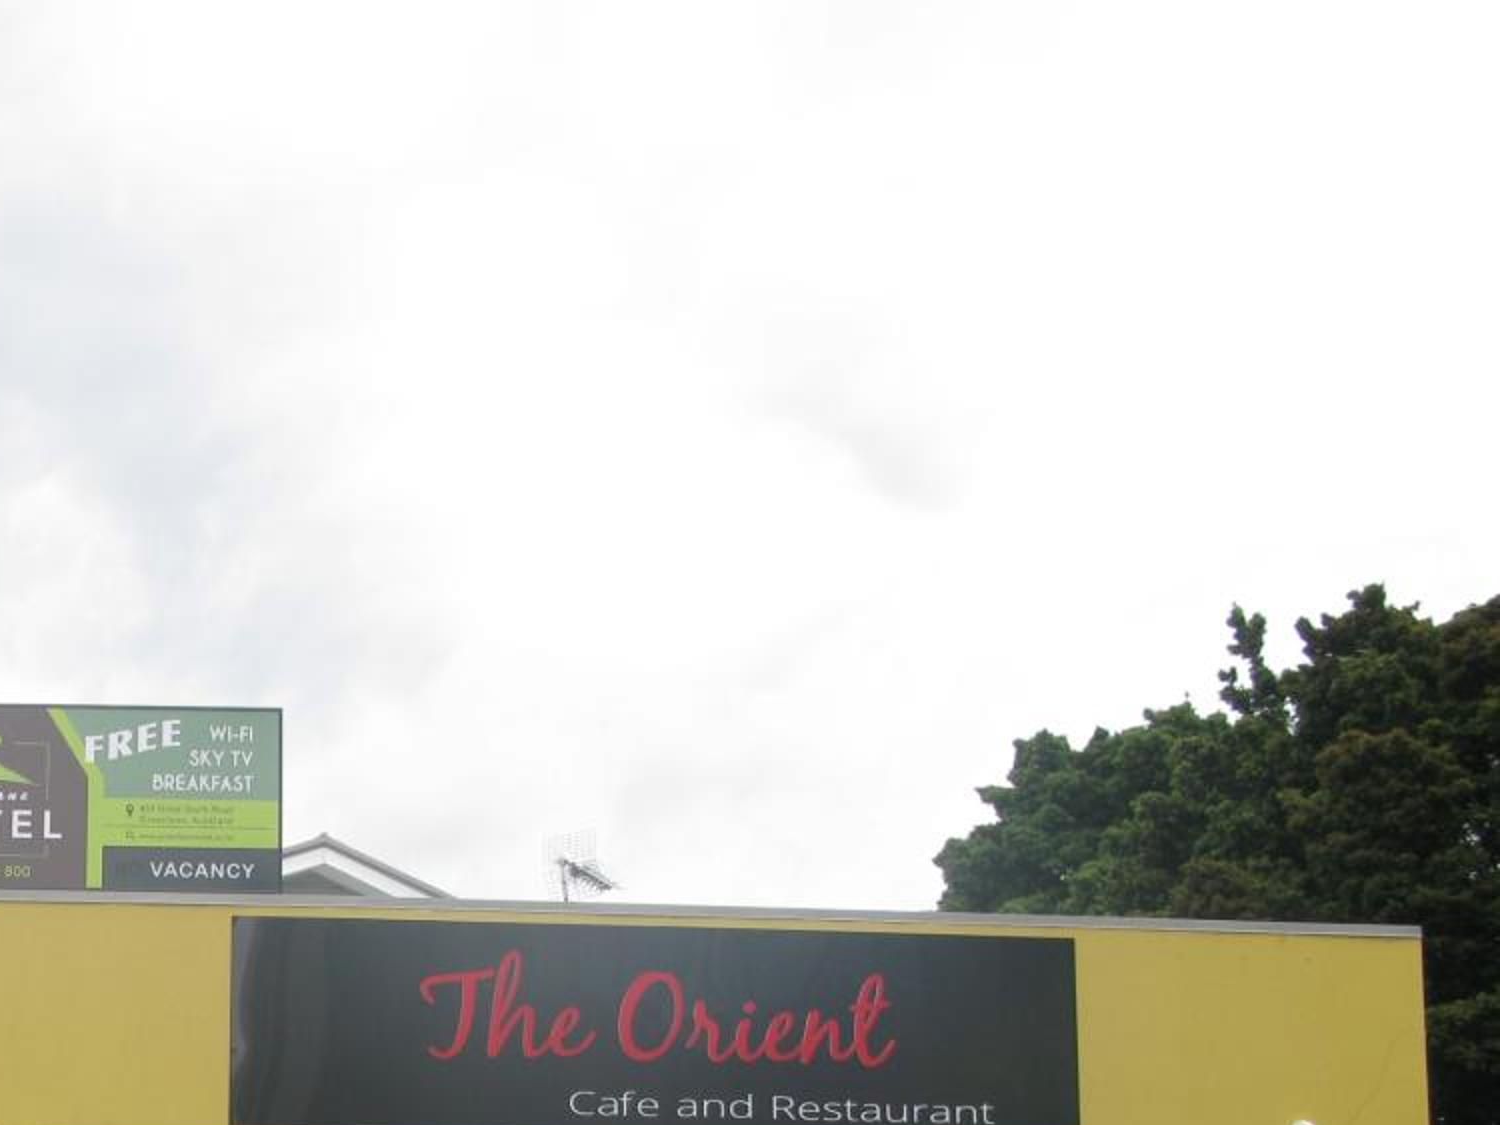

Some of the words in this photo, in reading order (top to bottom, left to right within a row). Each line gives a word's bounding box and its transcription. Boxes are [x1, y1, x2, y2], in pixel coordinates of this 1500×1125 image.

[84, 719, 181, 764] FREE
[210, 725, 253, 743] WI-FI
[189, 750, 225, 767] SKY
[232, 751, 253, 767] TV
[152, 774, 254, 793] BREAKFAST
[150, 861, 256, 880] VACANCY
[419, 948, 597, 1060] The
[616, 970, 897, 1068] Orient
[568, 1090, 660, 1119] Cafe
[677, 1093, 754, 1121] and
[772, 1095, 996, 1125] Restaurant
